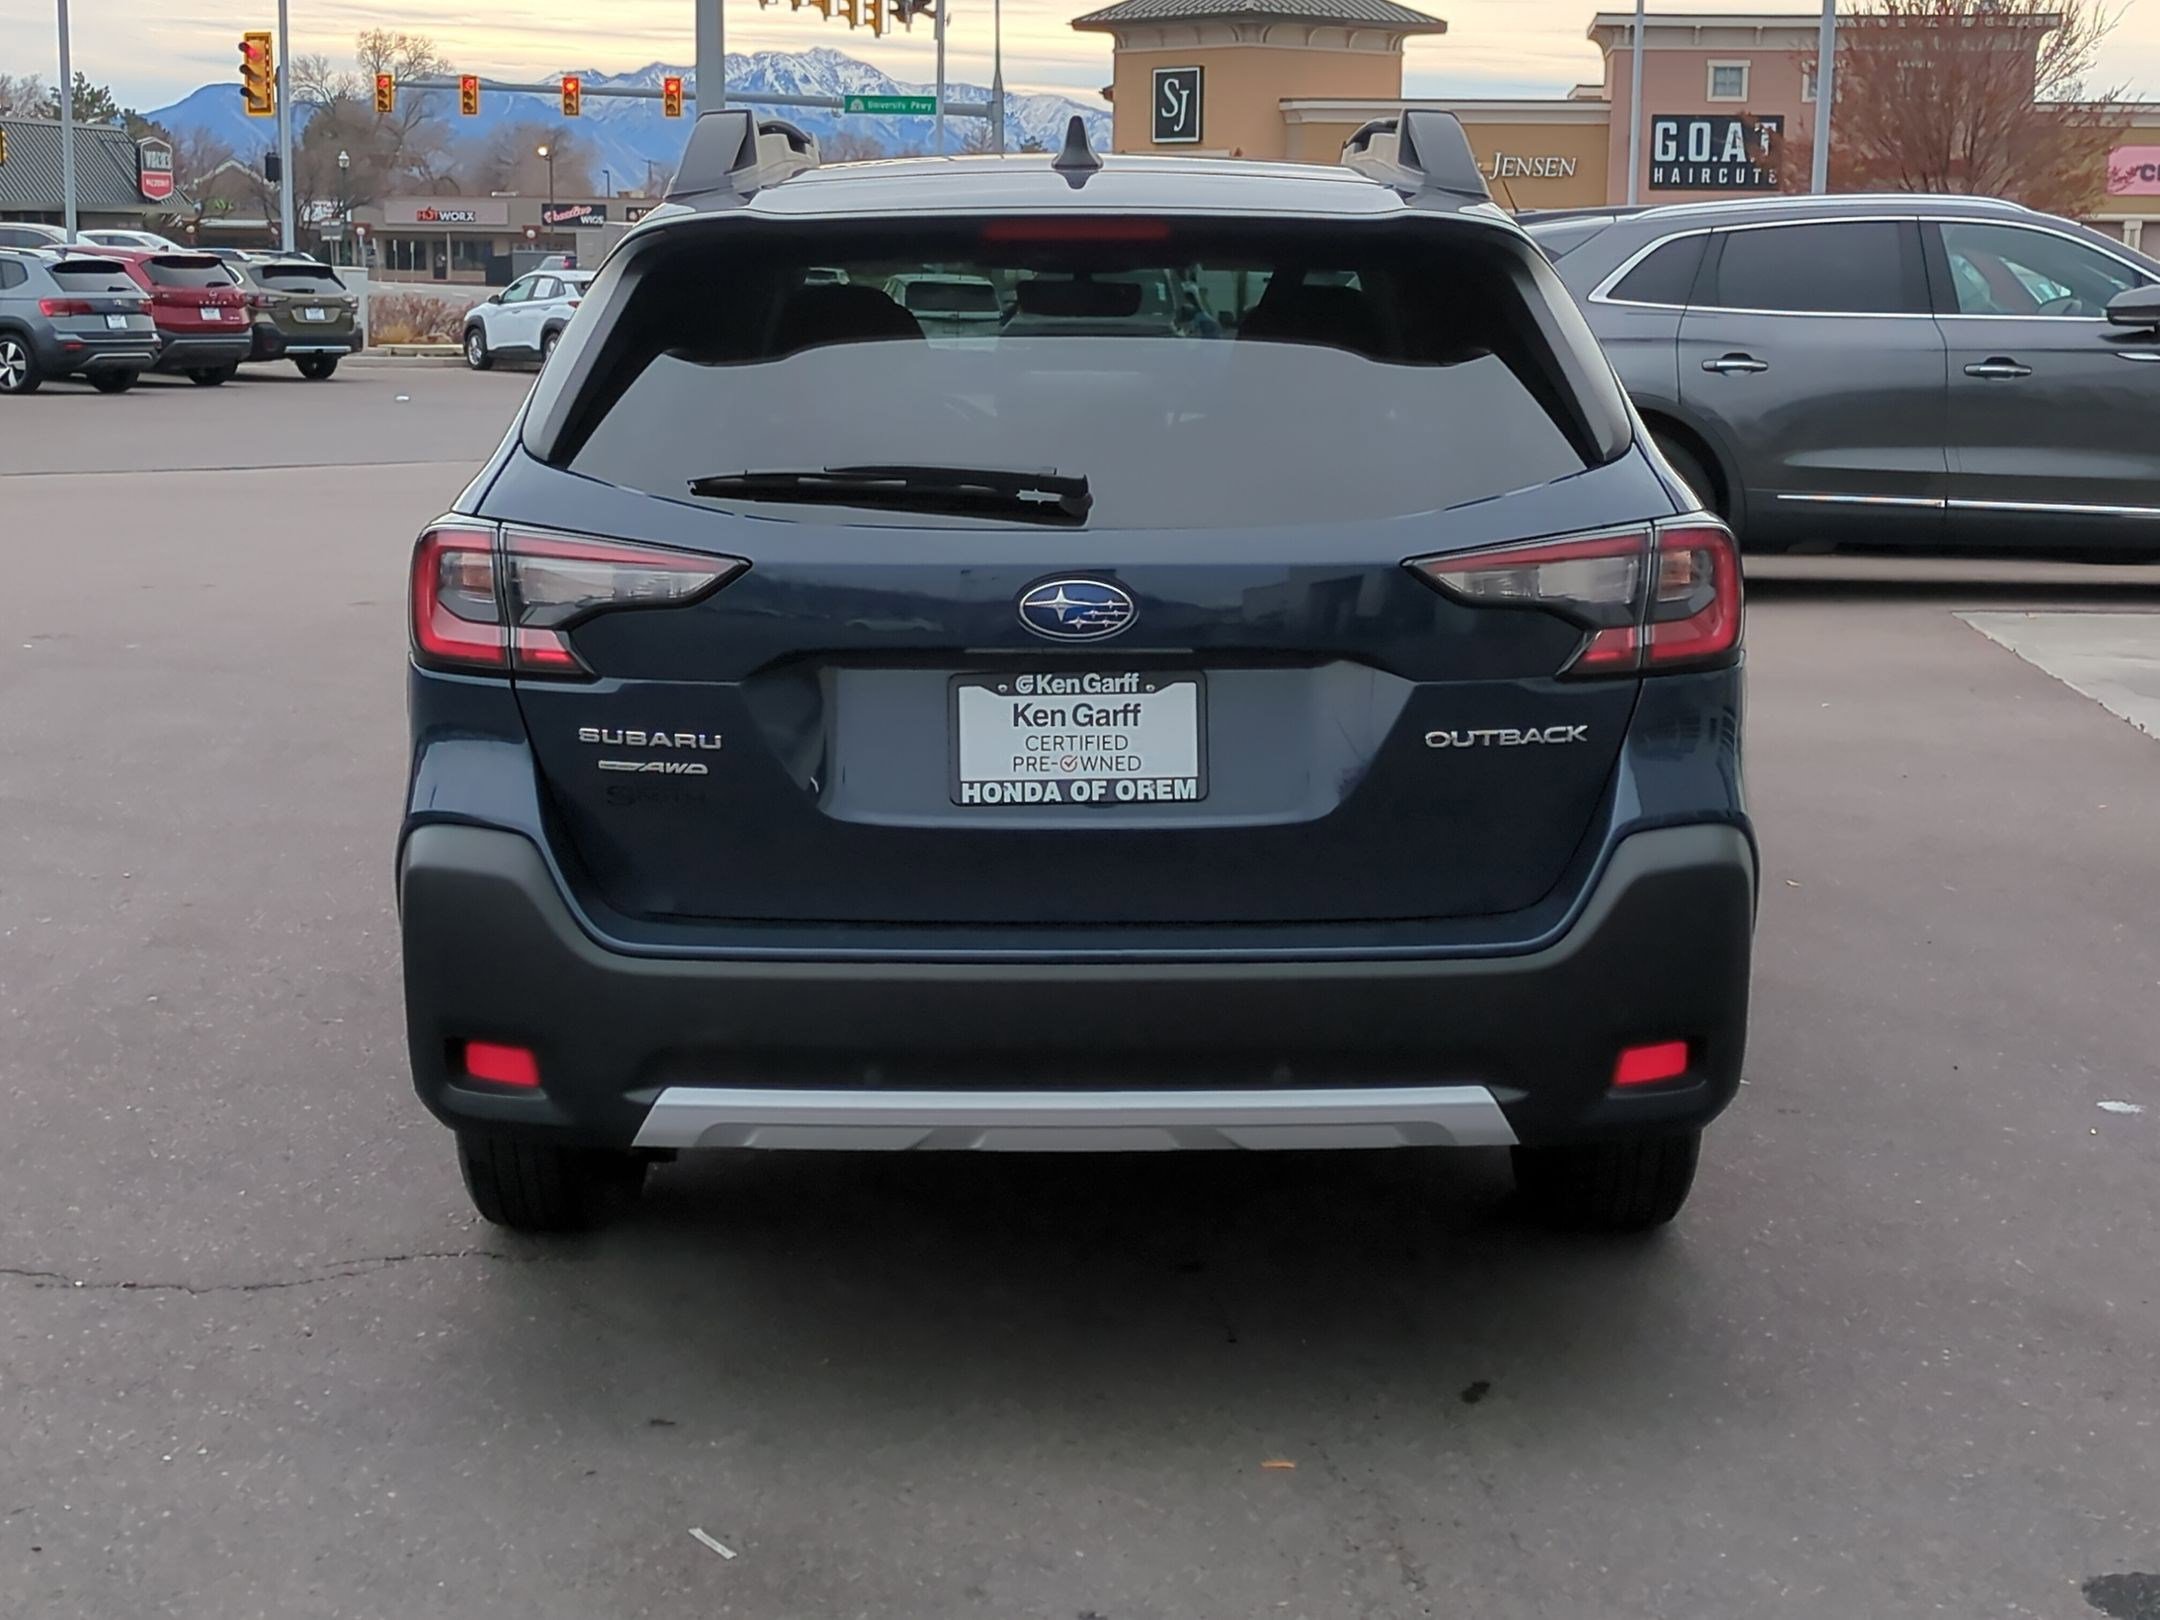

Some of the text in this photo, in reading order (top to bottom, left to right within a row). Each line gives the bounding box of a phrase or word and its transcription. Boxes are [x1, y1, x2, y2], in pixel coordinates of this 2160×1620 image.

[1488, 152, 1577, 180] JENSEN
[580, 214, 605, 225] WIGS
[1036, 674, 1080, 694] Ken
[1082, 672, 1140, 693] Garff
[1012, 702, 1142, 728] Ken Garff
[578, 727, 722, 750] SUBARU
[1025, 735, 1129, 752] CERTIFIED
[1424, 725, 1589, 748] OUTBACK
[638, 761, 709, 775] AWD
[961, 778, 1197, 804] HONDA OF OREM
